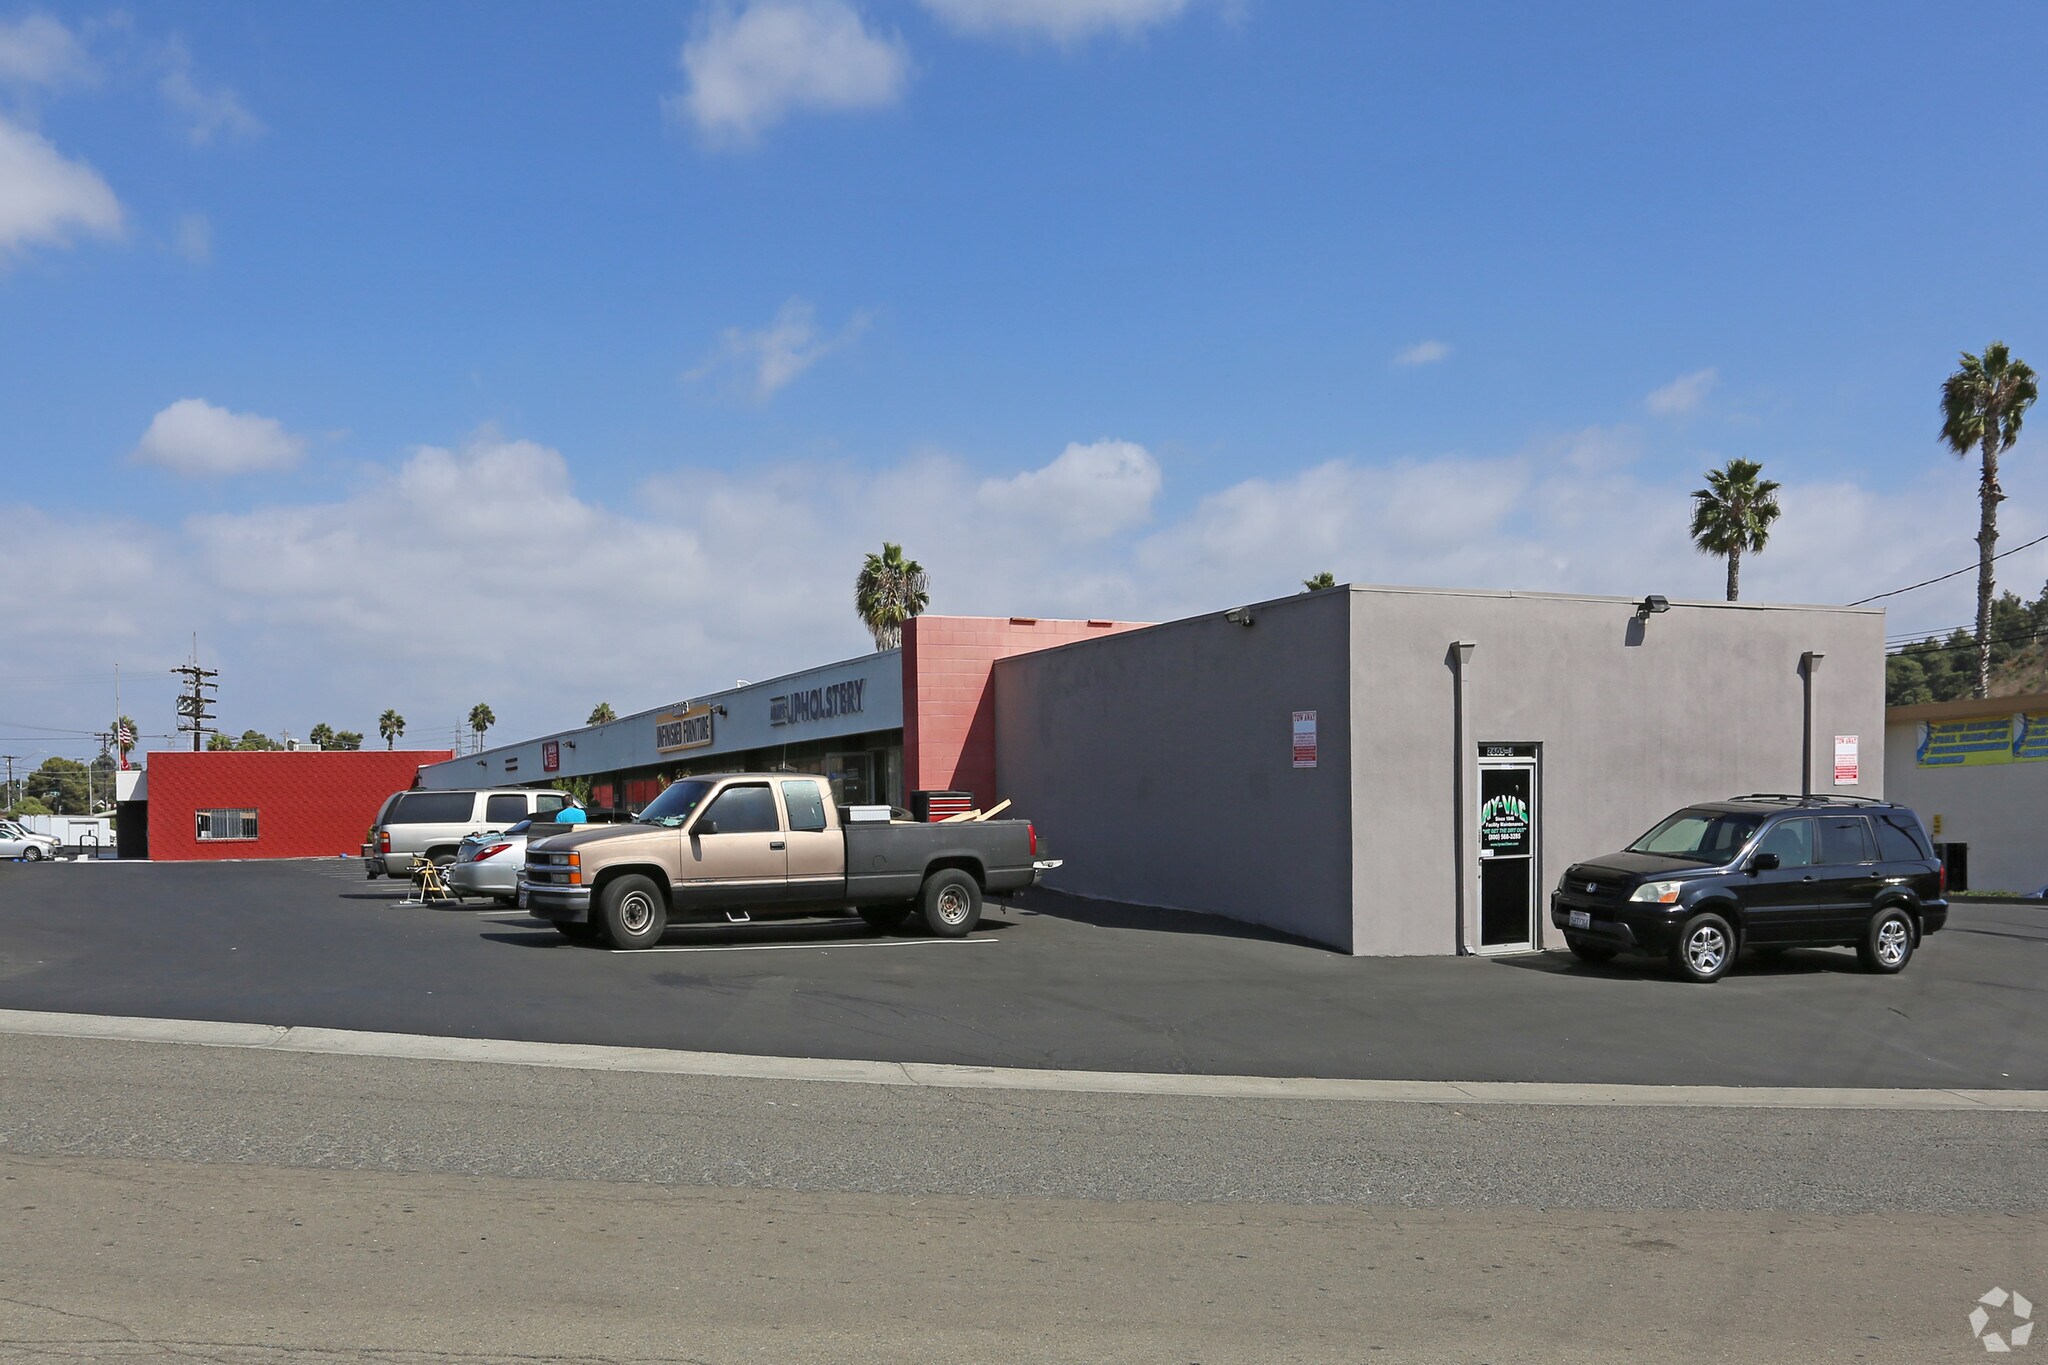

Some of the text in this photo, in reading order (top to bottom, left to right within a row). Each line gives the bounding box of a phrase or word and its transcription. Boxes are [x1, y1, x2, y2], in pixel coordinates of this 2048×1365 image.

[786, 678, 865, 724] UPHOLSTERY
[683, 715, 710, 744] FURNITURE
[1481, 795, 1528, 825] HY-VAC
